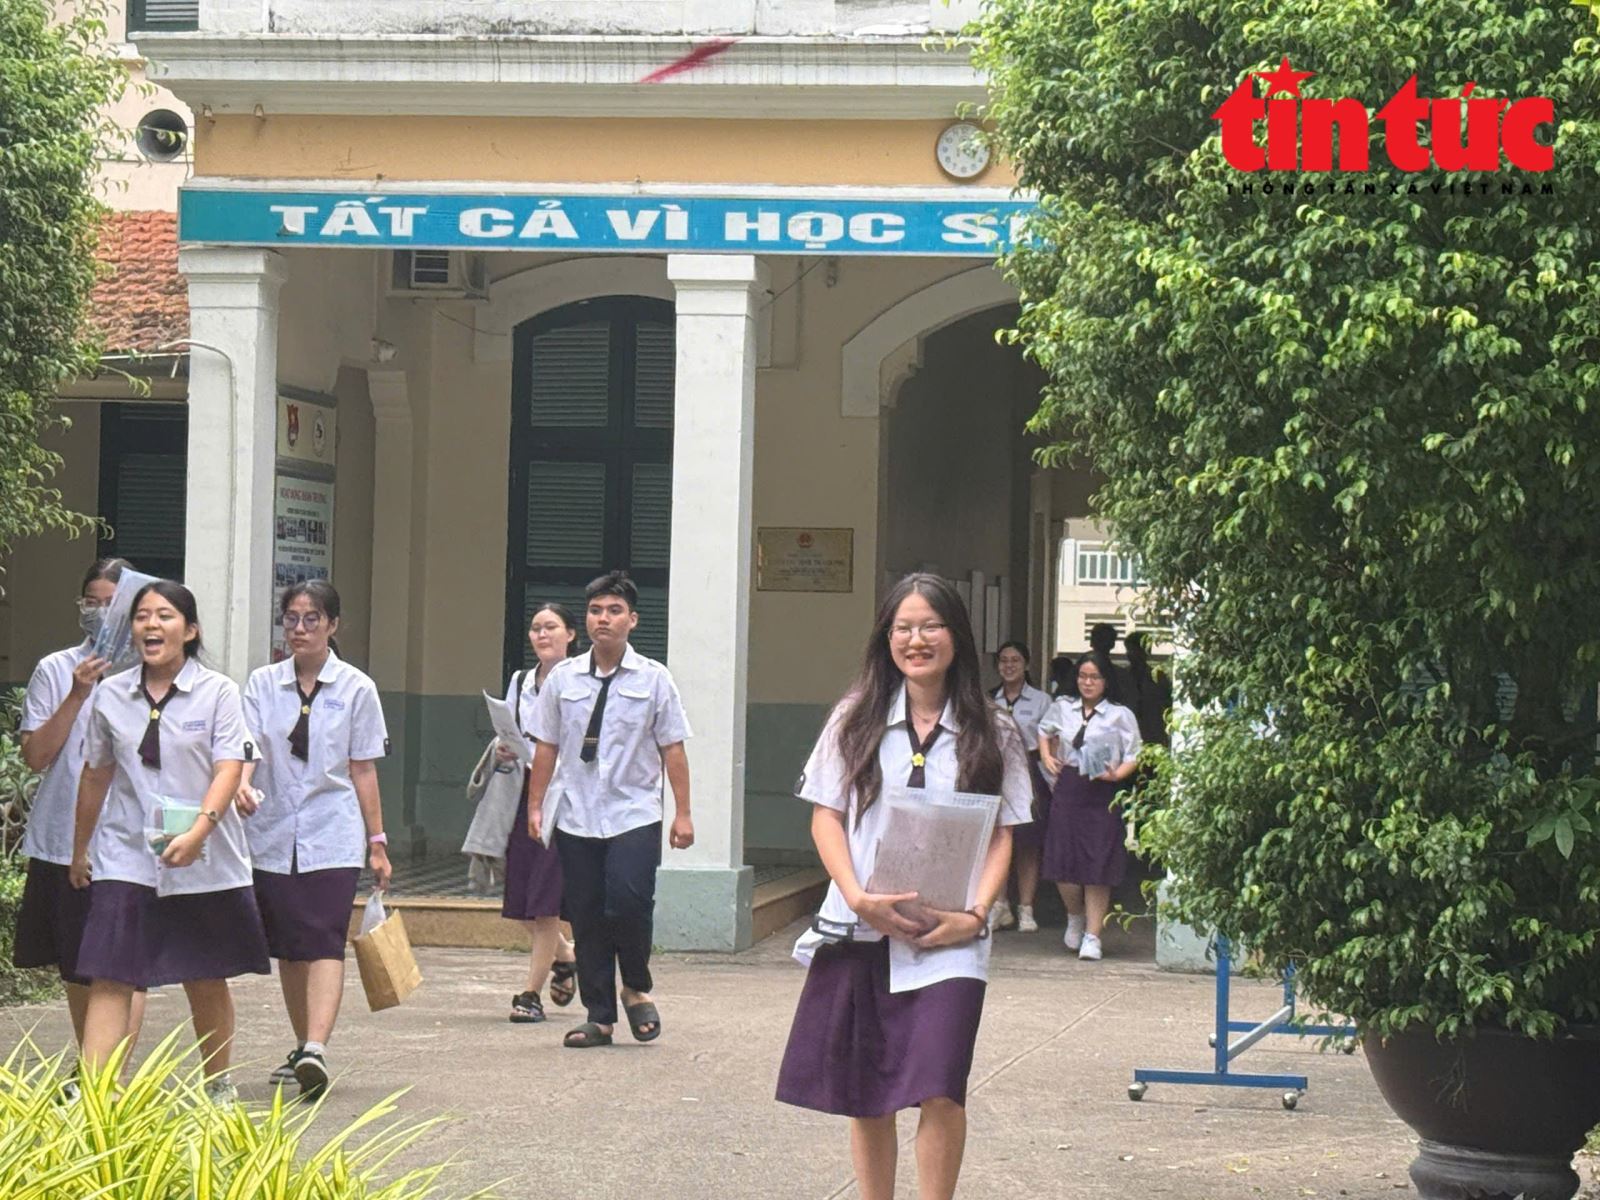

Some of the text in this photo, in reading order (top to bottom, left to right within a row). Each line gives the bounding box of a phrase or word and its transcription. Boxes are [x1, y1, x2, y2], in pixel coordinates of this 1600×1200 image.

[270, 196, 428, 237] TẤT
[459, 200, 580, 239] CẢ
[606, 203, 689, 241] VÌ
[725, 211, 906, 249] HỌC
